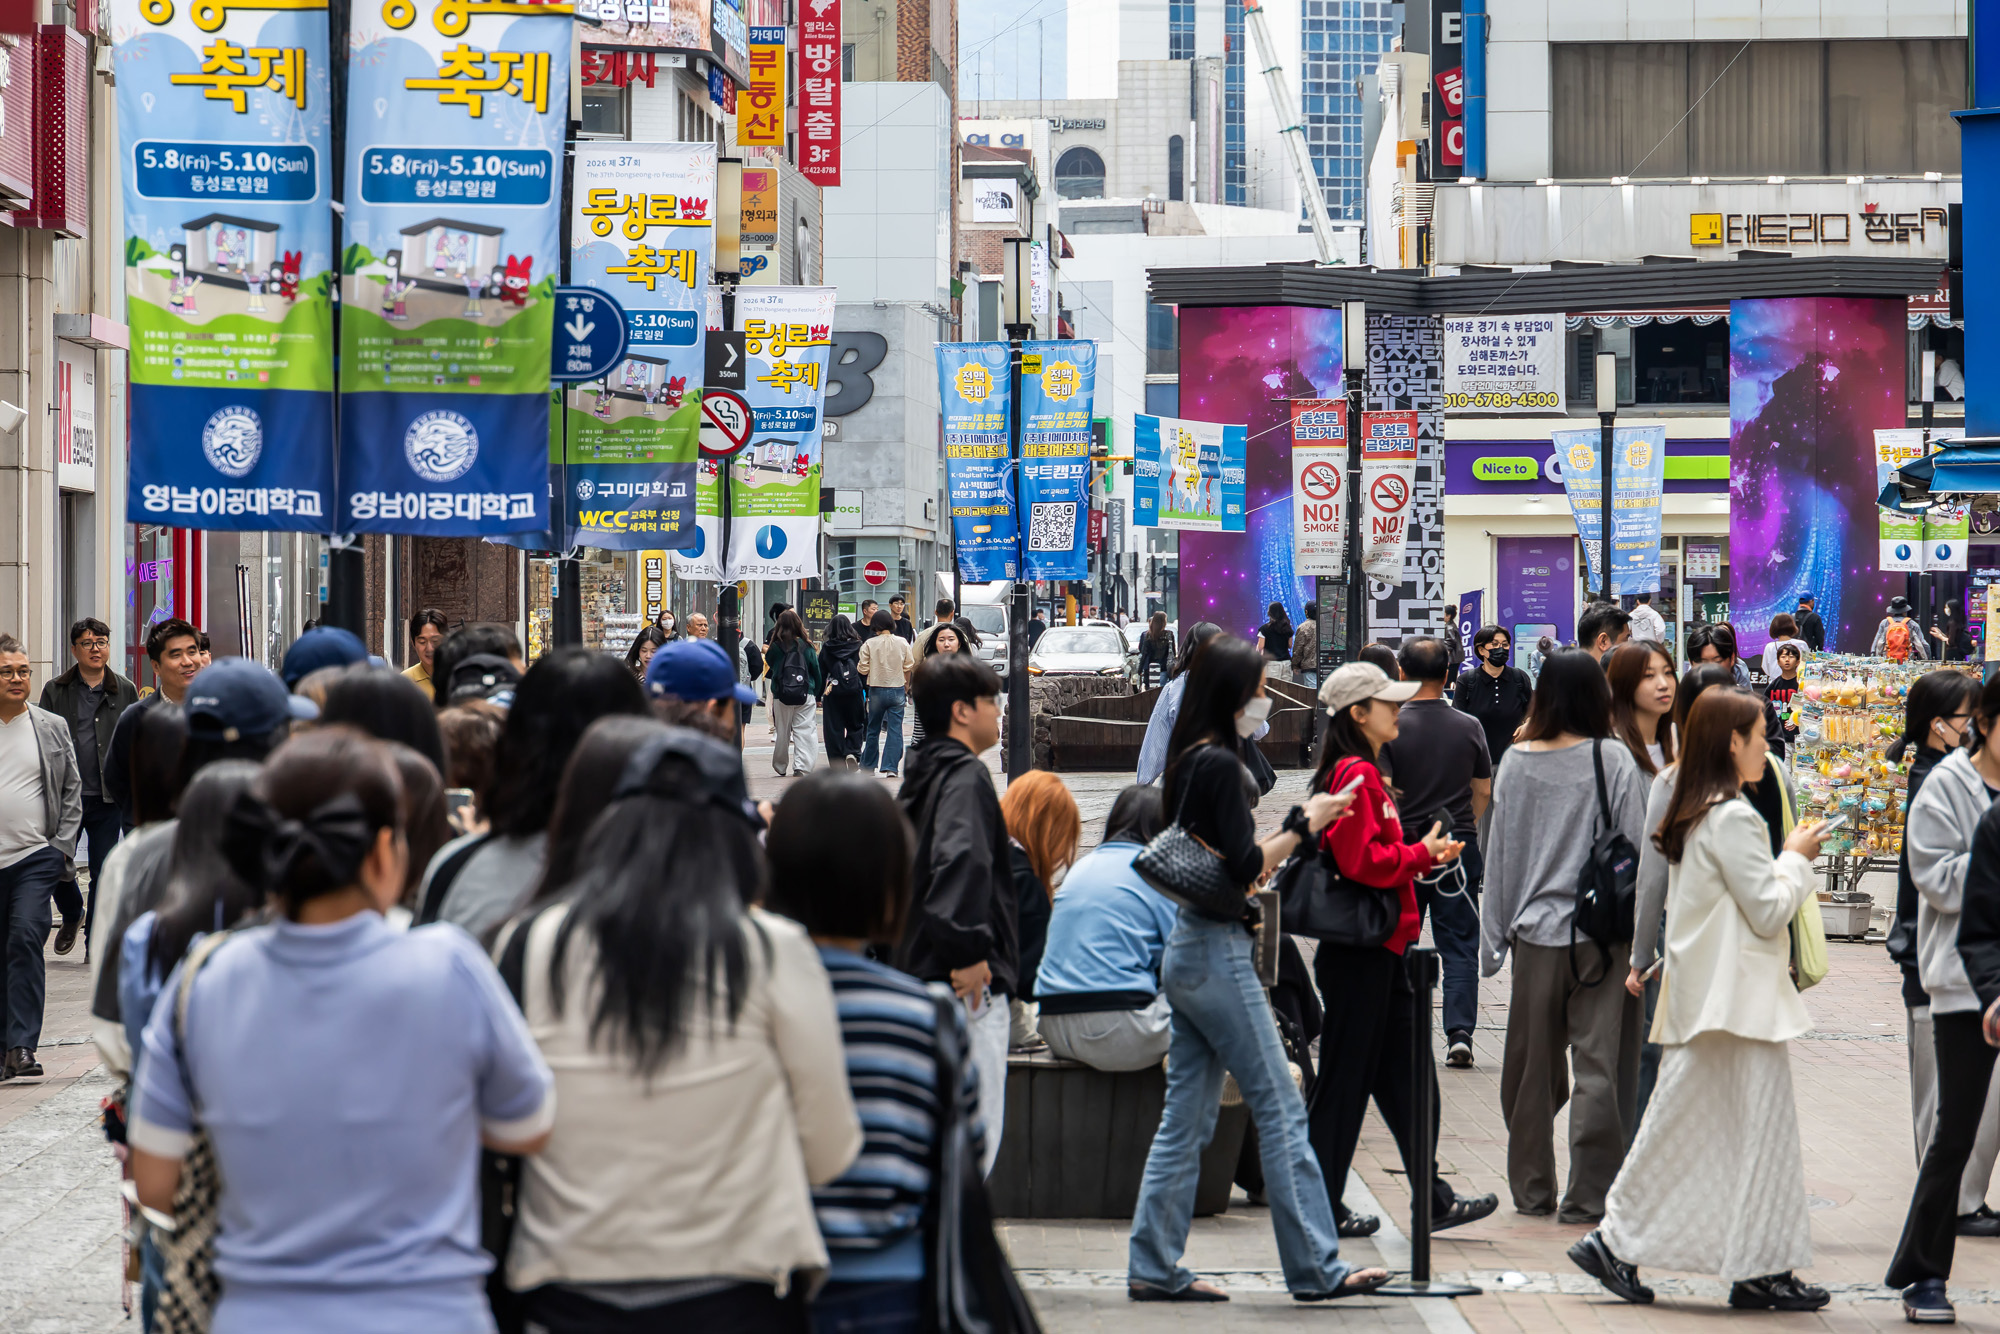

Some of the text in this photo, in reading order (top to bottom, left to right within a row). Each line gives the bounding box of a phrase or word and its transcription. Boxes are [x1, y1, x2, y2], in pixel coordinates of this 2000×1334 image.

[804, 21, 835, 33] 앨리스
[749, 29, 784, 42] 카데미
[671, 56, 681, 64] 3F
[170, 39, 307, 114] 축제
[405, 44, 550, 118] 축제
[746, 50, 779, 140] 부동산
[804, 44, 836, 140] 방탈출
[809, 145, 831, 163] 3F
[143, 149, 308, 174] 5.8(Fri)~5.10(Sun)
[370, 155, 546, 178] 5.8(Fri)~5.10(Sun)
[587, 159, 606, 167] 2026
[608, 158, 617, 167] 제
[587, 171, 686, 180] The 37th Dongseong-ro Festival
[809, 167, 836, 175] 422-8788
[191, 175, 269, 194] 동성로일원
[415, 180, 497, 198] 동성로일원
[748, 194, 762, 208] 수
[581, 188, 712, 241] 동성로
[740, 234, 774, 242] 25-0009
[606, 244, 697, 291] 축제
[756, 256, 765, 269] 2
[565, 296, 596, 313] 후방
[628, 314, 695, 329] ~5.10(Sun)
[1445, 320, 1553, 333] 어려운 경기 속 부담없이
[629, 331, 664, 341] 로일원
[744, 319, 832, 357] 동성로
[1461, 335, 1537, 347] 장사하실 수 있게
[568, 344, 592, 358] 지하
[1469, 350, 1528, 361] 심해돈까스가
[566, 360, 592, 372] 80m
[1457, 364, 1540, 376] 도와드리겠습니다.
[718, 370, 738, 378] 350m
[757, 360, 820, 393] 축제
[963, 386, 986, 398] 국비
[1050, 384, 1072, 396] 국비
[1462, 381, 1536, 391] 부담없이 전화주세요!
[1444, 392, 1559, 407] 010-6788-4500
[1300, 411, 1339, 425] 동성로
[760, 421, 796, 430] 동성로일원
[1295, 426, 1345, 439] 금연거리
[1371, 423, 1408, 437] 동성로
[1366, 437, 1415, 452] 금연거리
[1879, 445, 1923, 463] 동성로
[1024, 464, 1083, 480] 부트캠프
[1482, 463, 1527, 474] Nice to
[597, 481, 687, 498] 구미대학교
[142, 484, 323, 516] 영남이공대학교
[350, 491, 536, 520] 영남이공대학교
[631, 510, 680, 520] 교육부 선정
[834, 505, 861, 514] rocs
[1303, 504, 1340, 522] NO!
[579, 510, 629, 527] WCC
[1372, 516, 1405, 535] NO!
[629, 522, 679, 532] 세계적 대학
[1303, 523, 1339, 532] SMOKE
[1373, 535, 1401, 545] SMOKE
[646, 558, 662, 624] 필름부
[805, 608, 833, 619] 방탈출
